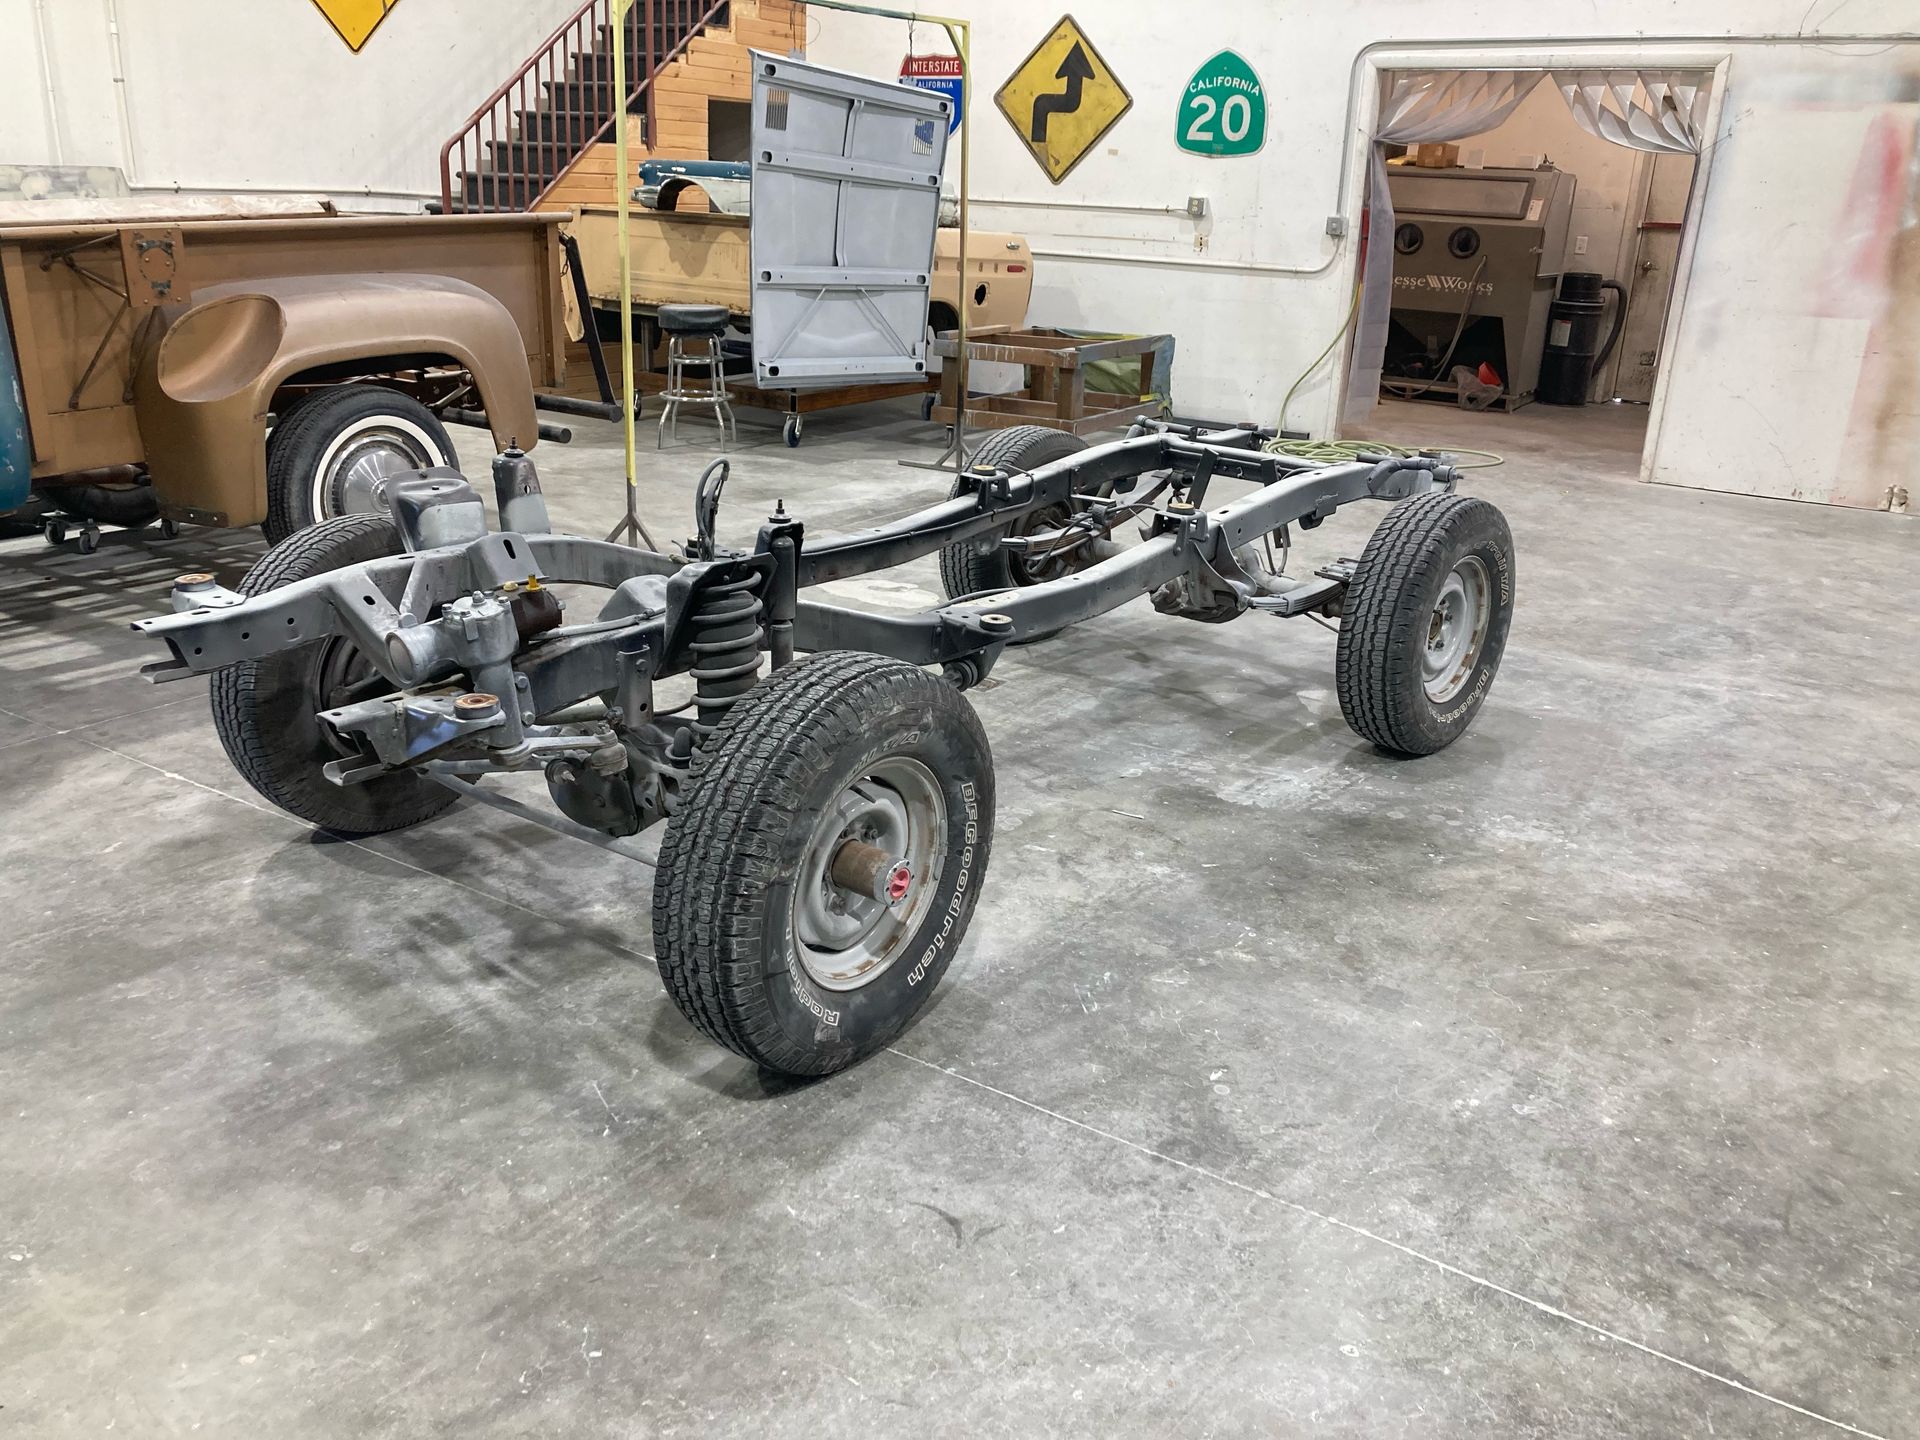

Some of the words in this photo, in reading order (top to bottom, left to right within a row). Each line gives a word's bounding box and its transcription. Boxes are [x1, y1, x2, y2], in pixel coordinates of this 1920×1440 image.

[909, 60, 960, 73] INTERSTATE
[917, 80, 954, 89] ALIFORNIA
[1189, 76, 1260, 97] CALIFORNIA
[1186, 94, 1251, 142] 20
[1392, 275, 1426, 287] esse
[907, 782, 978, 987] BFGoodrich
